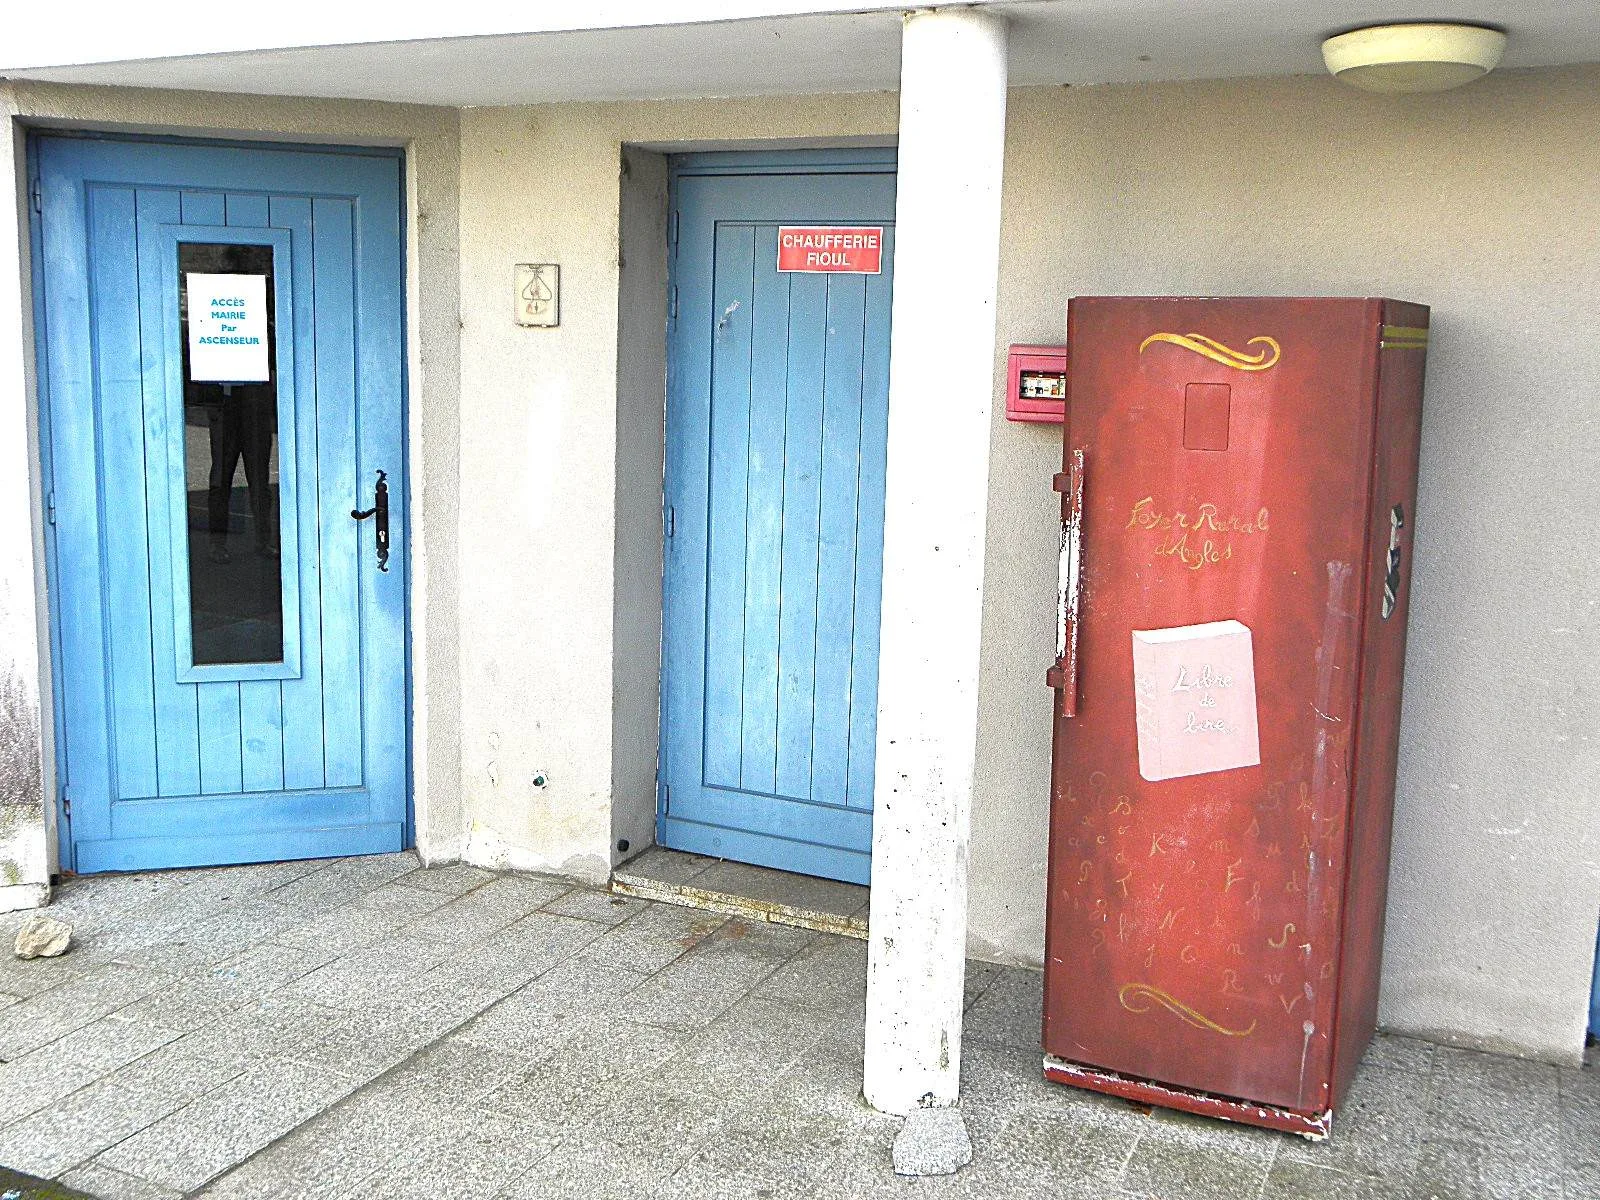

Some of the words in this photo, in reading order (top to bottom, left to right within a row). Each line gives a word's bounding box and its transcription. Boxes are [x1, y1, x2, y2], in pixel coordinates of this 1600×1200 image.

[782, 234, 878, 249] CHAUFFERIE
[806, 252, 850, 266] FIOUL
[210, 297, 245, 307] ACCÈS
[210, 311, 246, 320] MAIRIE
[221, 324, 237, 332] Par
[198, 336, 260, 345] ASCENSEUR
[1149, 833, 1166, 857] K
